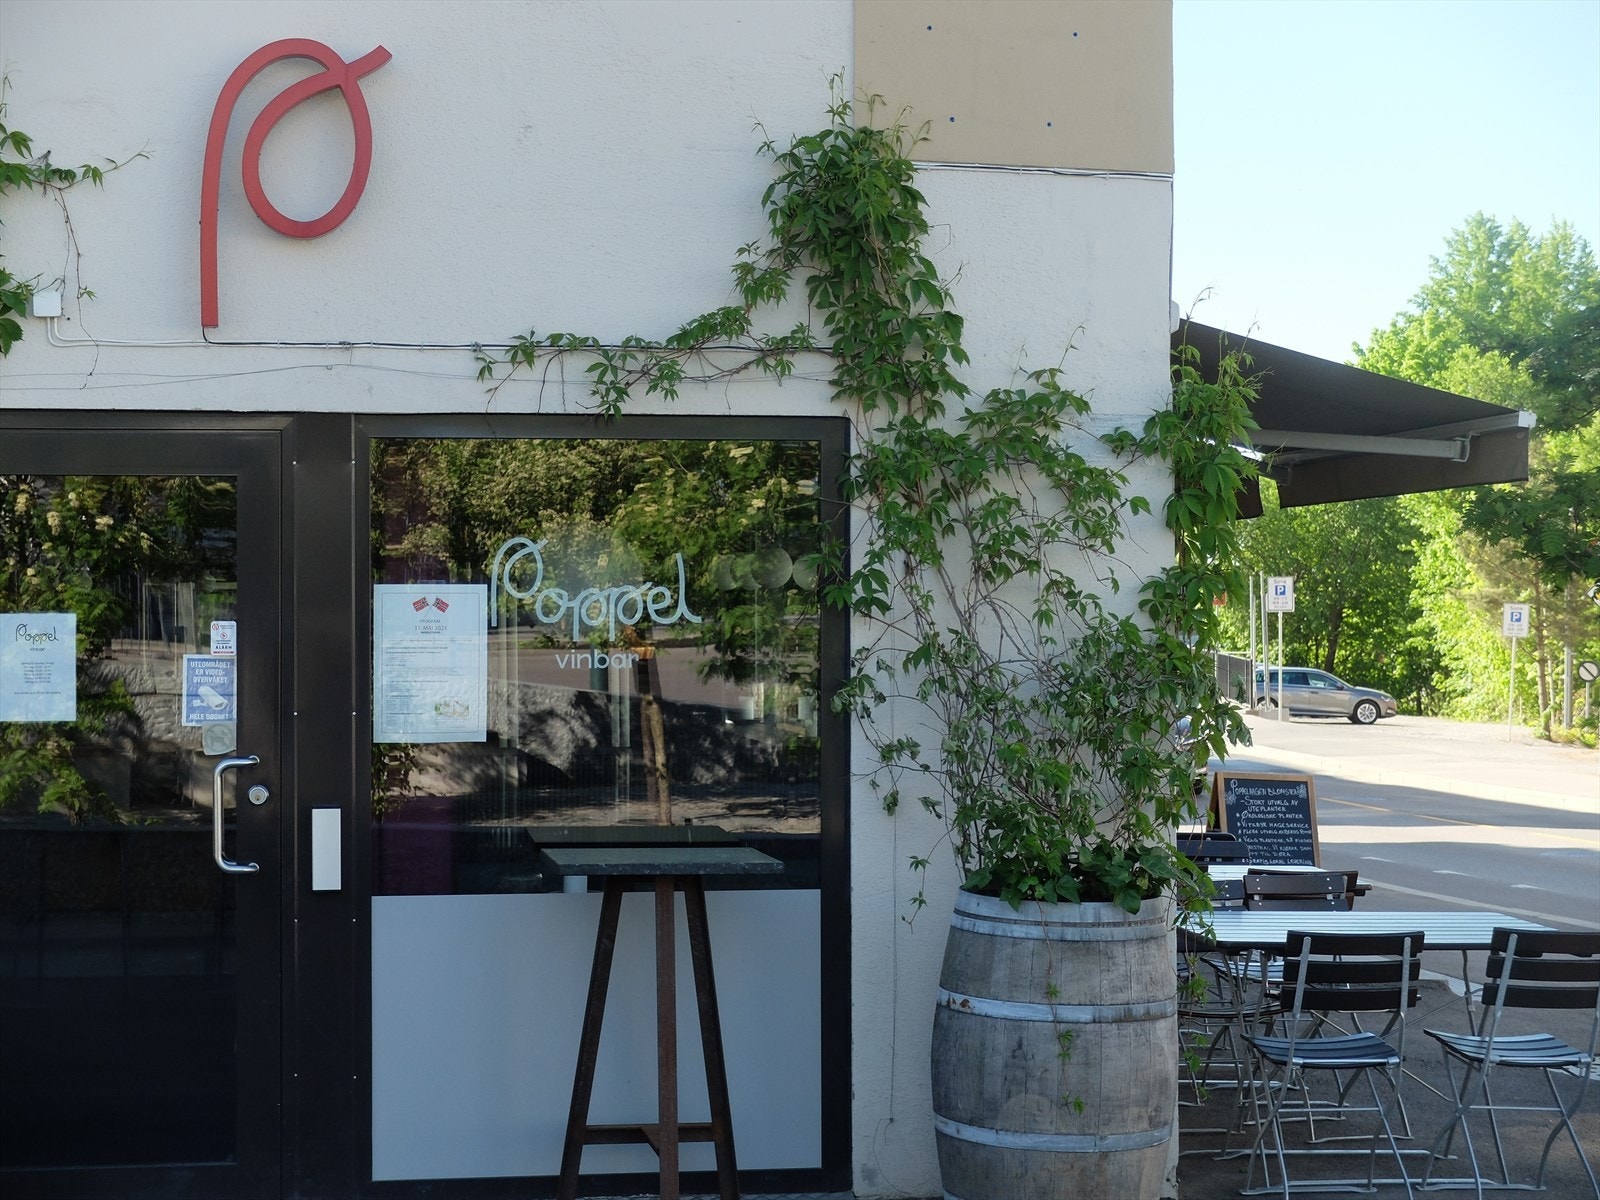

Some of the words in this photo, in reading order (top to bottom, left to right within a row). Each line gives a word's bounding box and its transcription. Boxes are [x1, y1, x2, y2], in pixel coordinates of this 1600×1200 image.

[200, 38, 393, 328] P
[490, 537, 702, 642] Poppel
[1277, 585, 1285, 595] P
[1512, 612, 1520, 622] P
[15, 623, 59, 645] Poppel
[190, 660, 231, 668] UTEOMRÅDET
[555, 650, 640, 670] vinbar
[192, 675, 228, 683] OVERVÅKET
